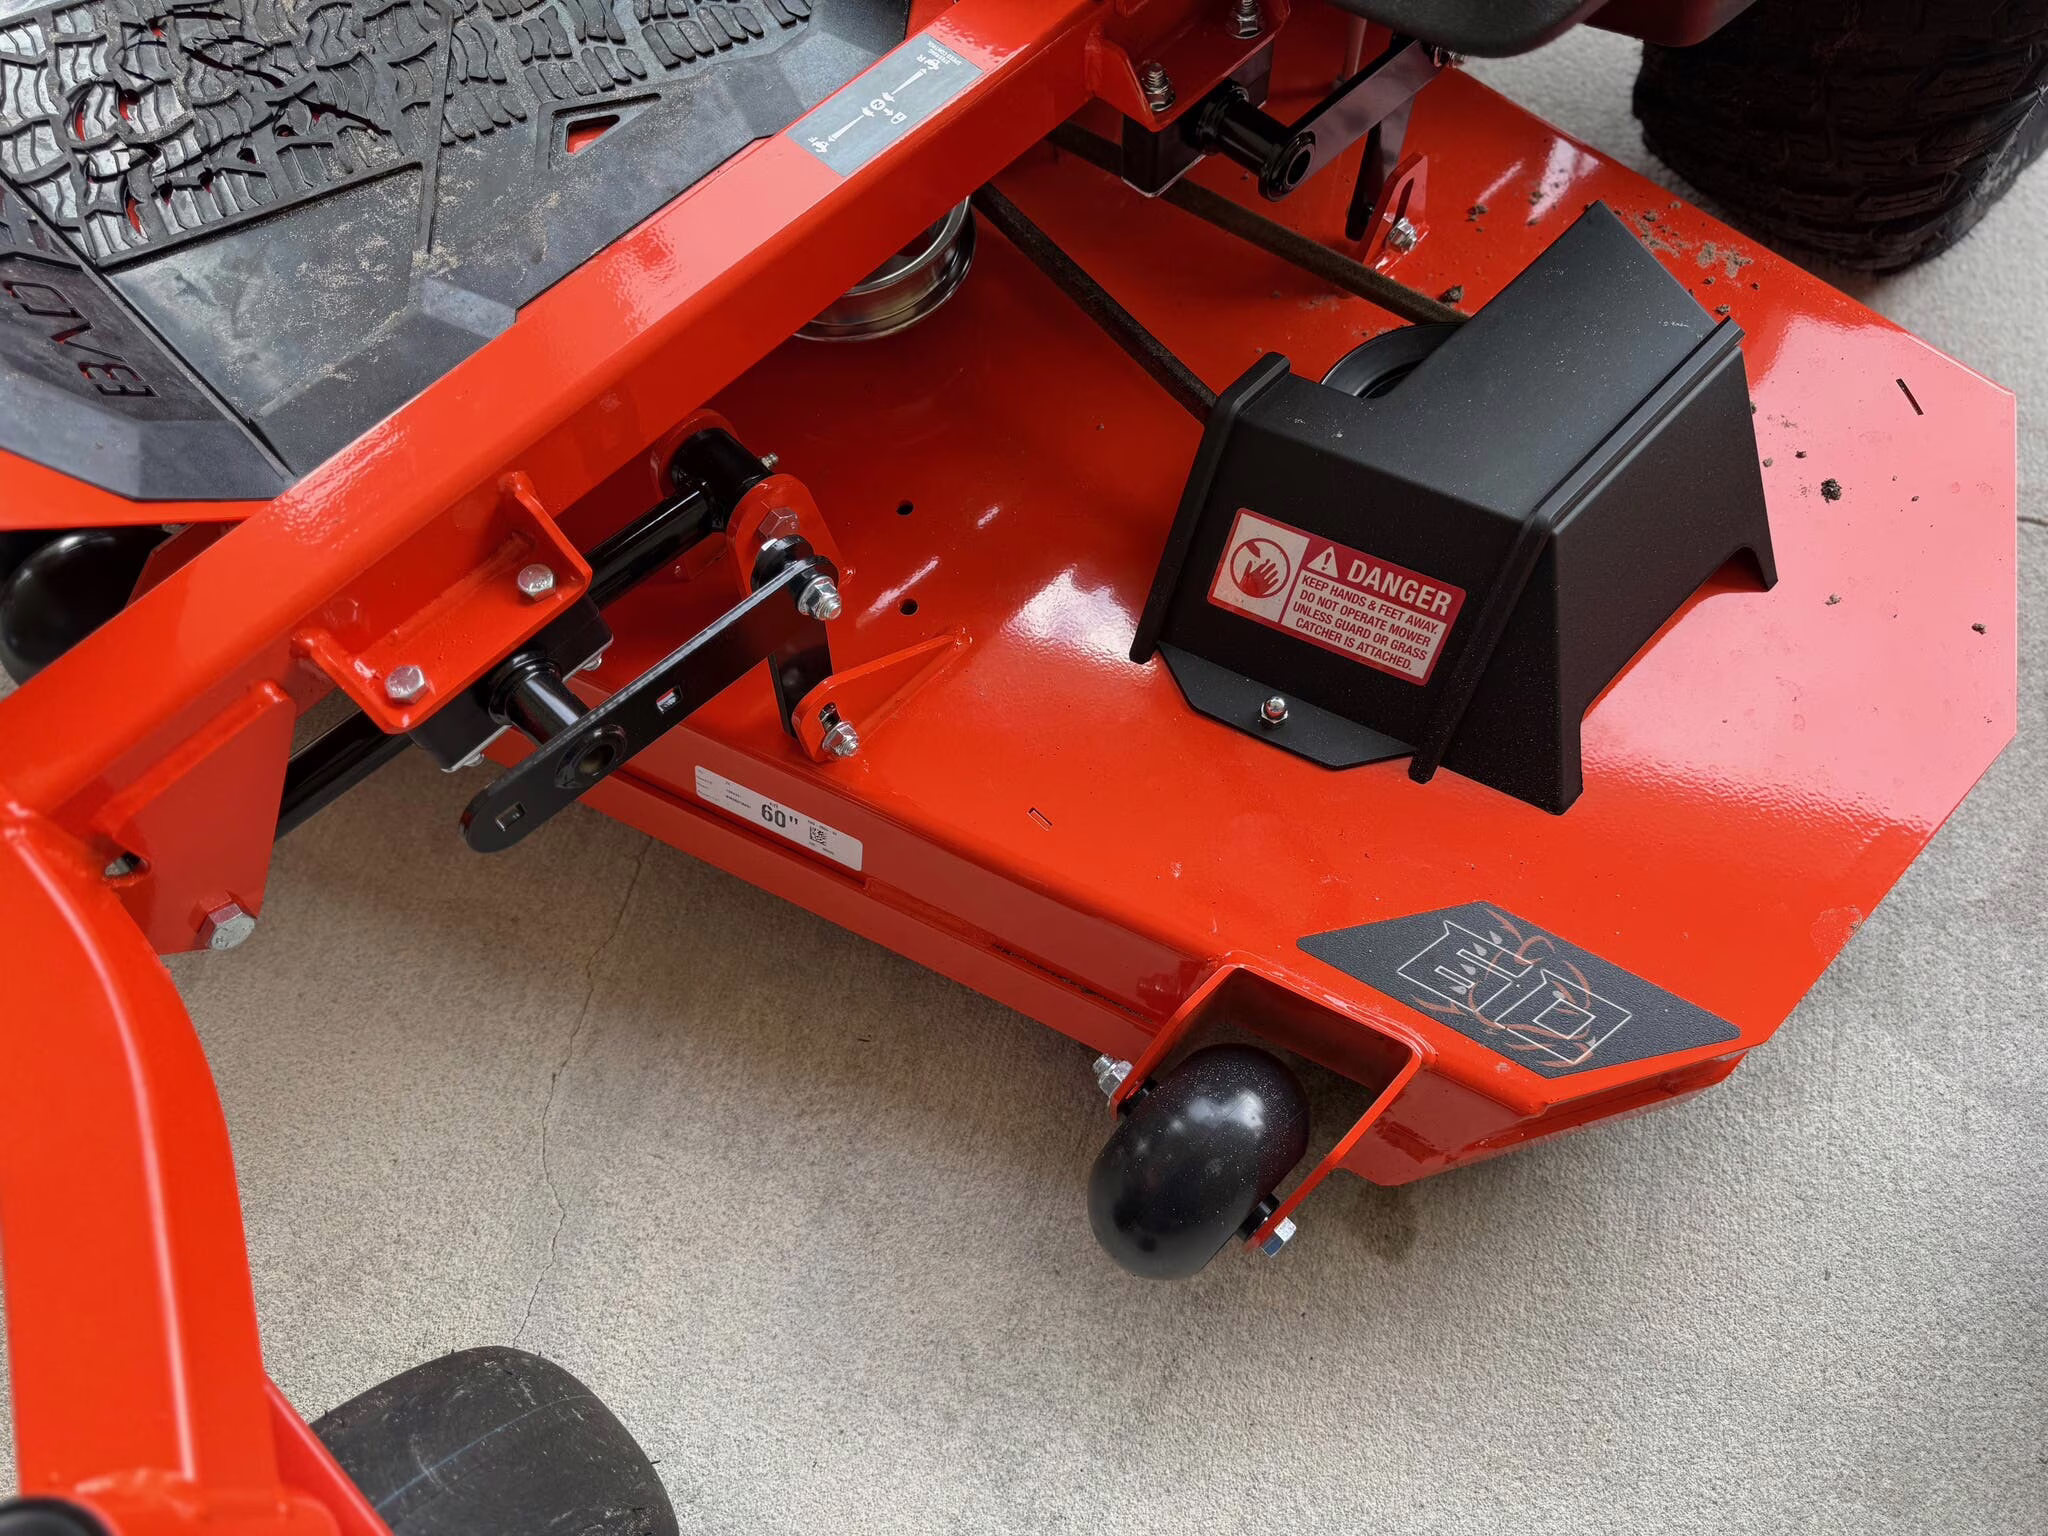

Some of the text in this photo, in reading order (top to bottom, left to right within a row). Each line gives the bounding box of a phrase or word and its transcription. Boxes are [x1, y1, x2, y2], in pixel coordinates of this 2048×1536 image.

[916, 53, 927, 63] R
[2, 279, 161, 398] BAD
[1302, 574, 1439, 635] KEEP HANDS & FEET AWAY.
[1347, 559, 1452, 617] DANGER
[1292, 601, 1428, 661] UNLESS GUARD OR GRASS
[1295, 617, 1412, 671] CATCHER IS ATTACHED.
[1299, 589, 1431, 648] DO NOT OPERATE MOWER
[761, 803, 799, 829] 60"
